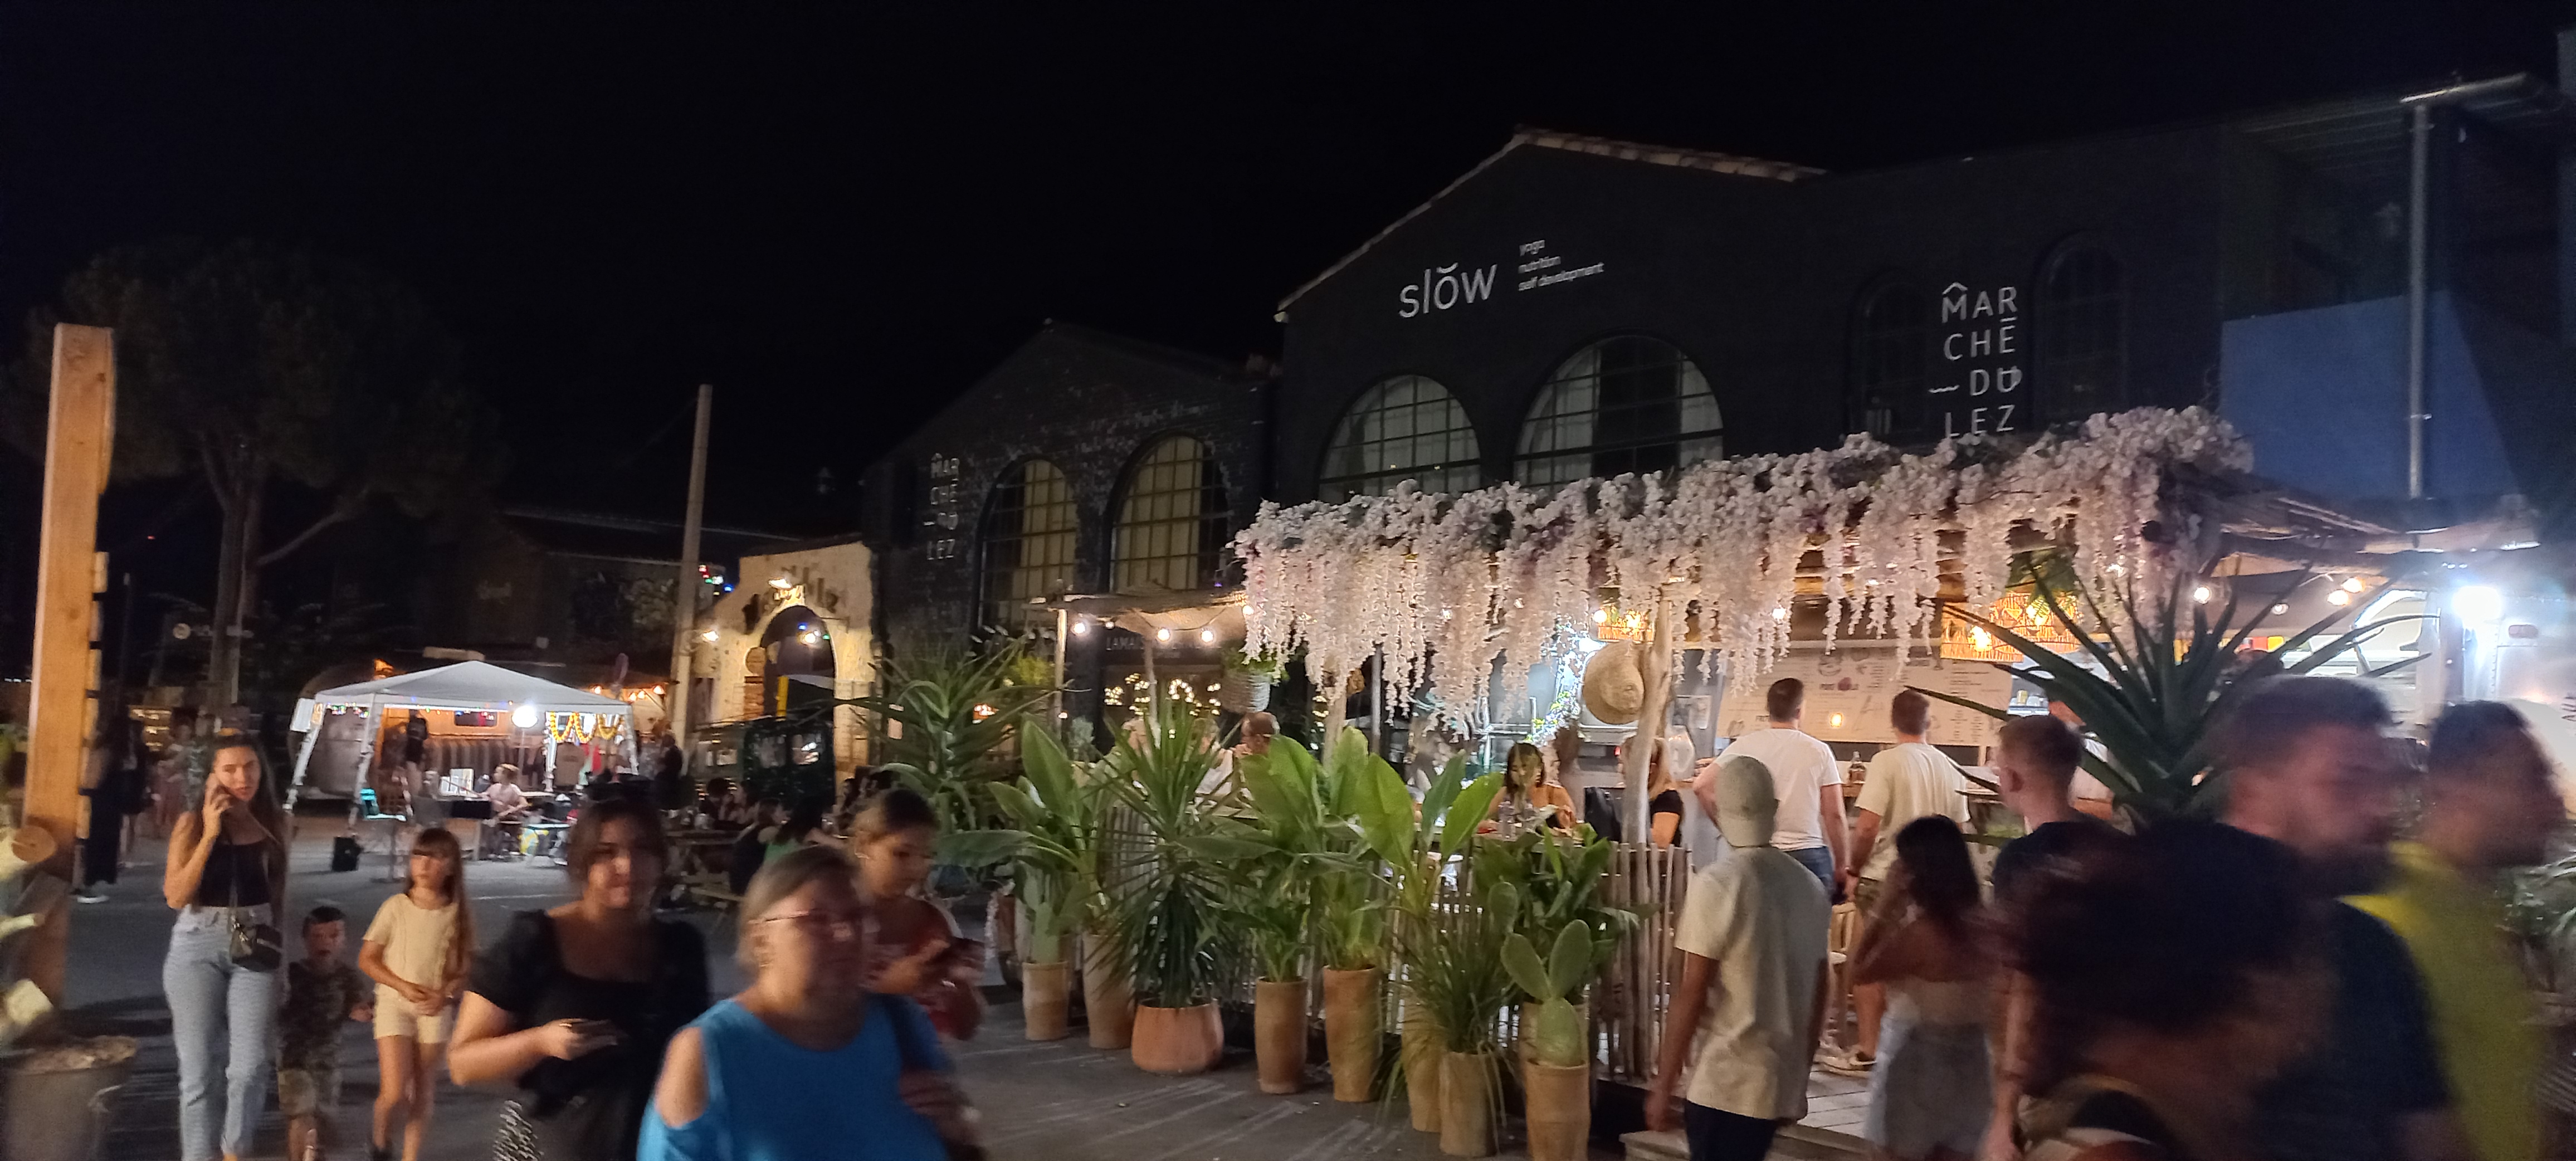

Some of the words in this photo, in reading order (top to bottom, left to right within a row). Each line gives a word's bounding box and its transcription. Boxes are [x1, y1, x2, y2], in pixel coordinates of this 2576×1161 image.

[1519, 240, 1545, 256] yoga
[1518, 276, 1538, 291] self
[1538, 262, 1604, 287] development
[1945, 404, 2016, 438] LEZ
[926, 538, 955, 560] LEZ
